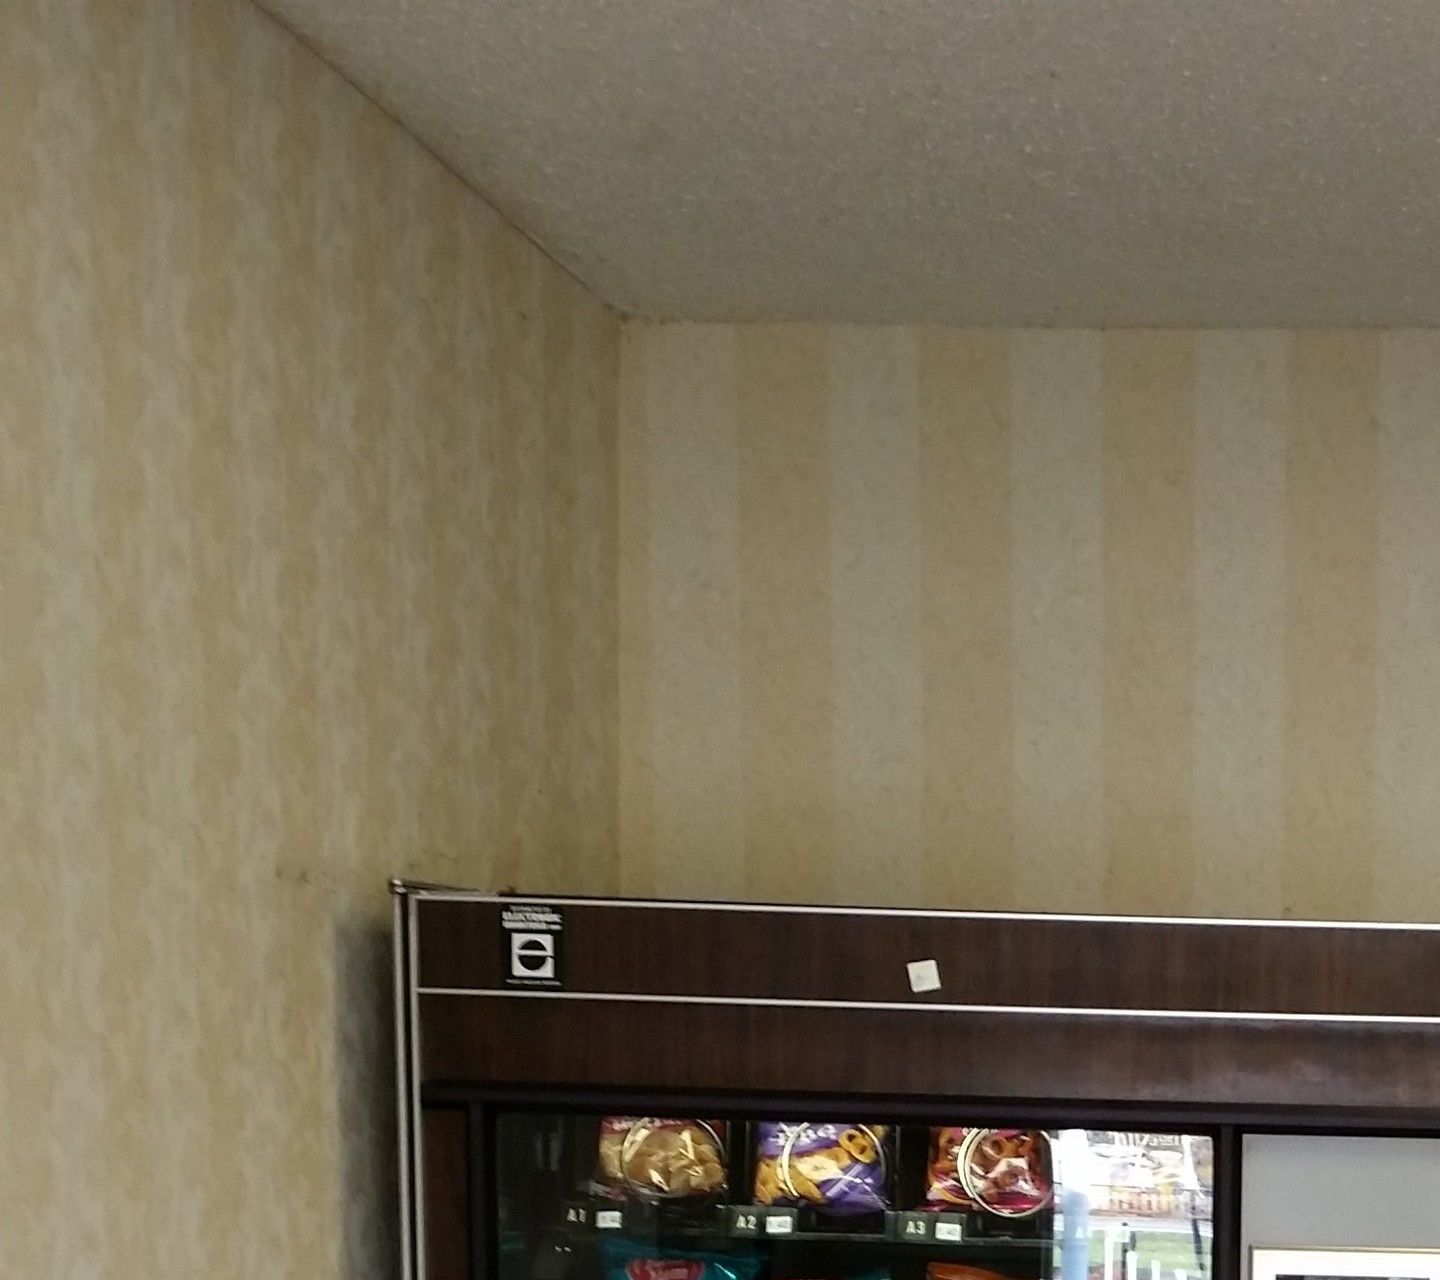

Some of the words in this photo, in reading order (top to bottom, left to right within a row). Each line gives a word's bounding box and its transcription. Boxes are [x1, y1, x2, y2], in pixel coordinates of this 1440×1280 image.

[566, 1207, 587, 1223] A1
[736, 1214, 757, 1230] A2
[906, 1220, 927, 1235] A3
